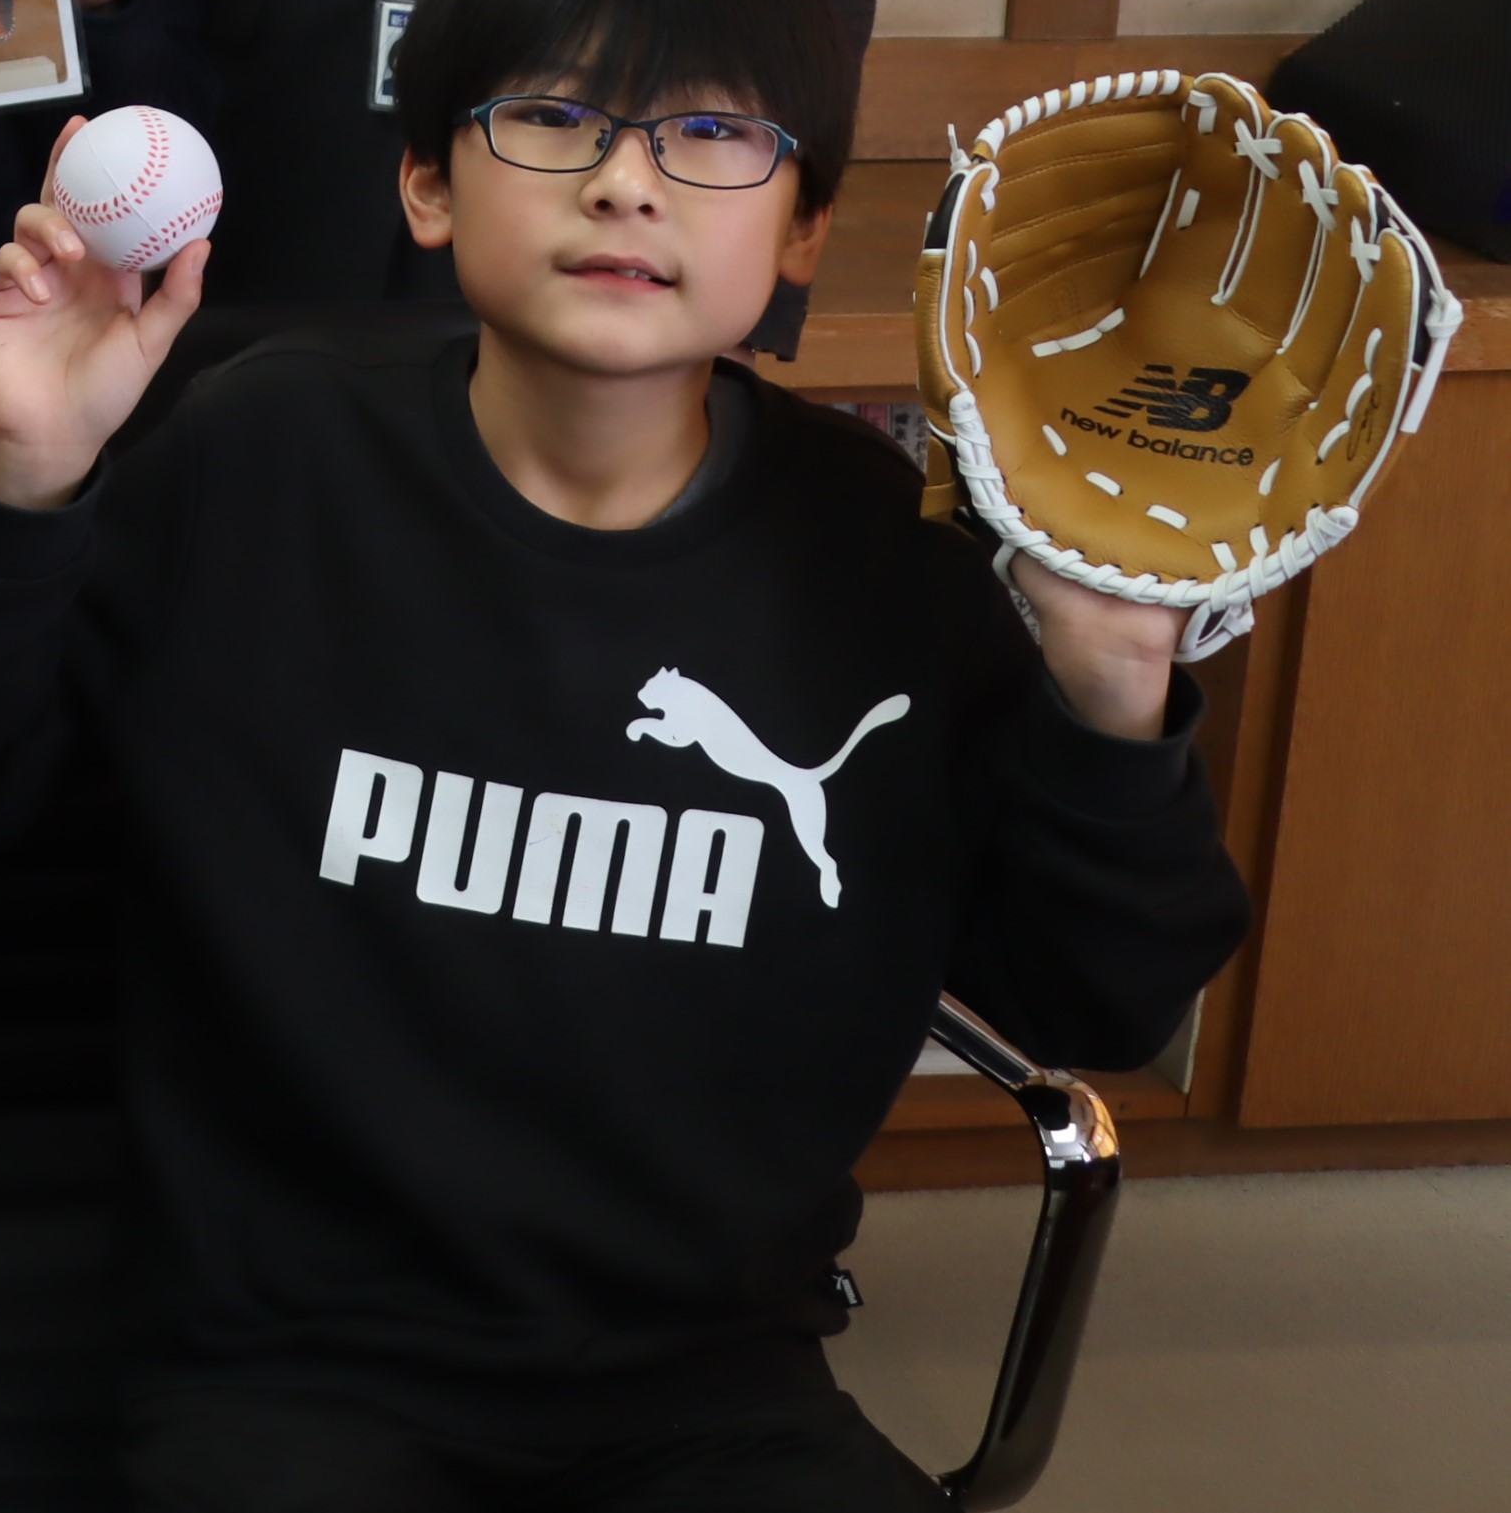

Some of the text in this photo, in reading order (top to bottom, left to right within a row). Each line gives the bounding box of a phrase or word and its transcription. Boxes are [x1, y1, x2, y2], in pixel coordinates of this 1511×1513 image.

[1060, 407, 1254, 466] new balance
[318, 747, 765, 949] PUMA
